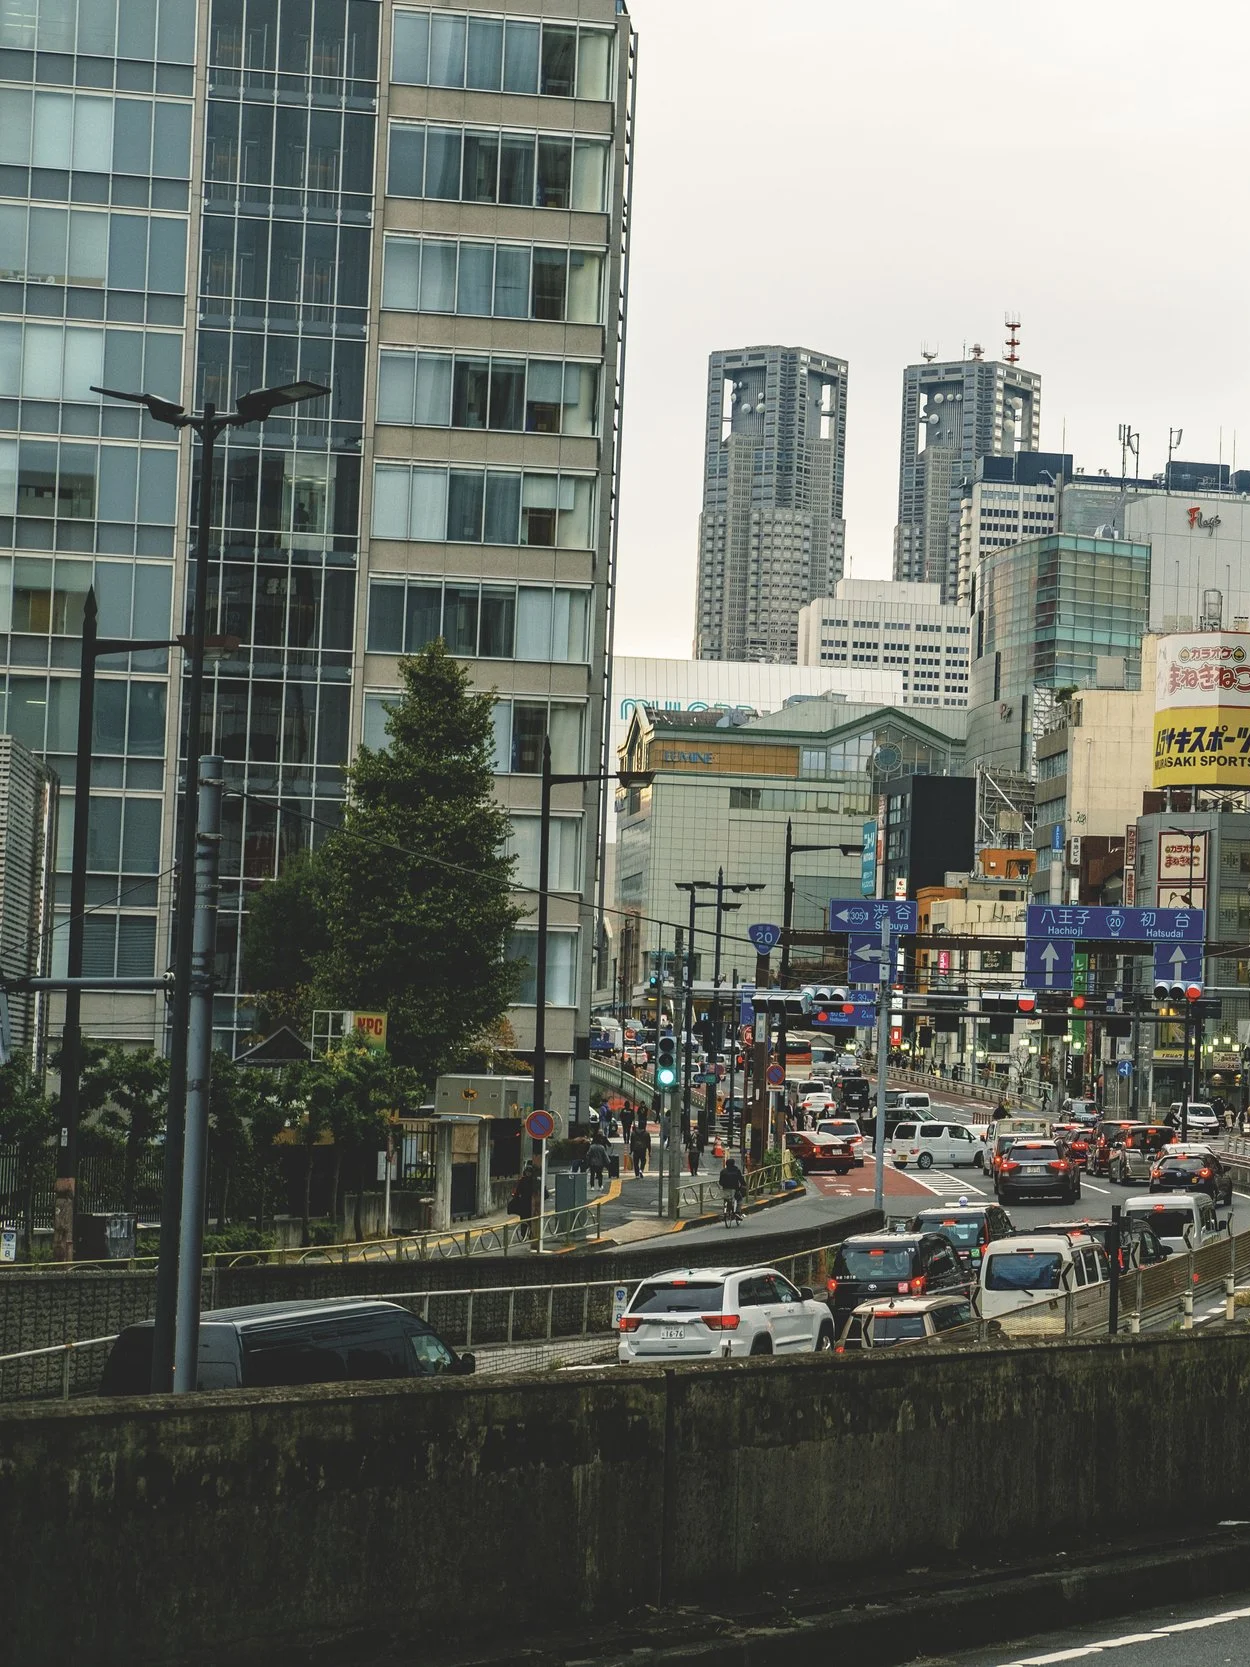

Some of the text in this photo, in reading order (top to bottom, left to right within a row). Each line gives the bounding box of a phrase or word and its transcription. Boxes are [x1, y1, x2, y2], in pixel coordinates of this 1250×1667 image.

[1188, 507, 1221, 536] Flags
[1191, 646, 1232, 660] カラオケ
[664, 751, 713, 764] LUMINE
[873, 904, 911, 920] 渋谷
[1041, 909, 1190, 928] 八王子 20 初台
[756, 933, 773, 943] 20
[1048, 926, 1184, 938] Hachioji Hatsudai
[357, 1016, 383, 1036] NPC
